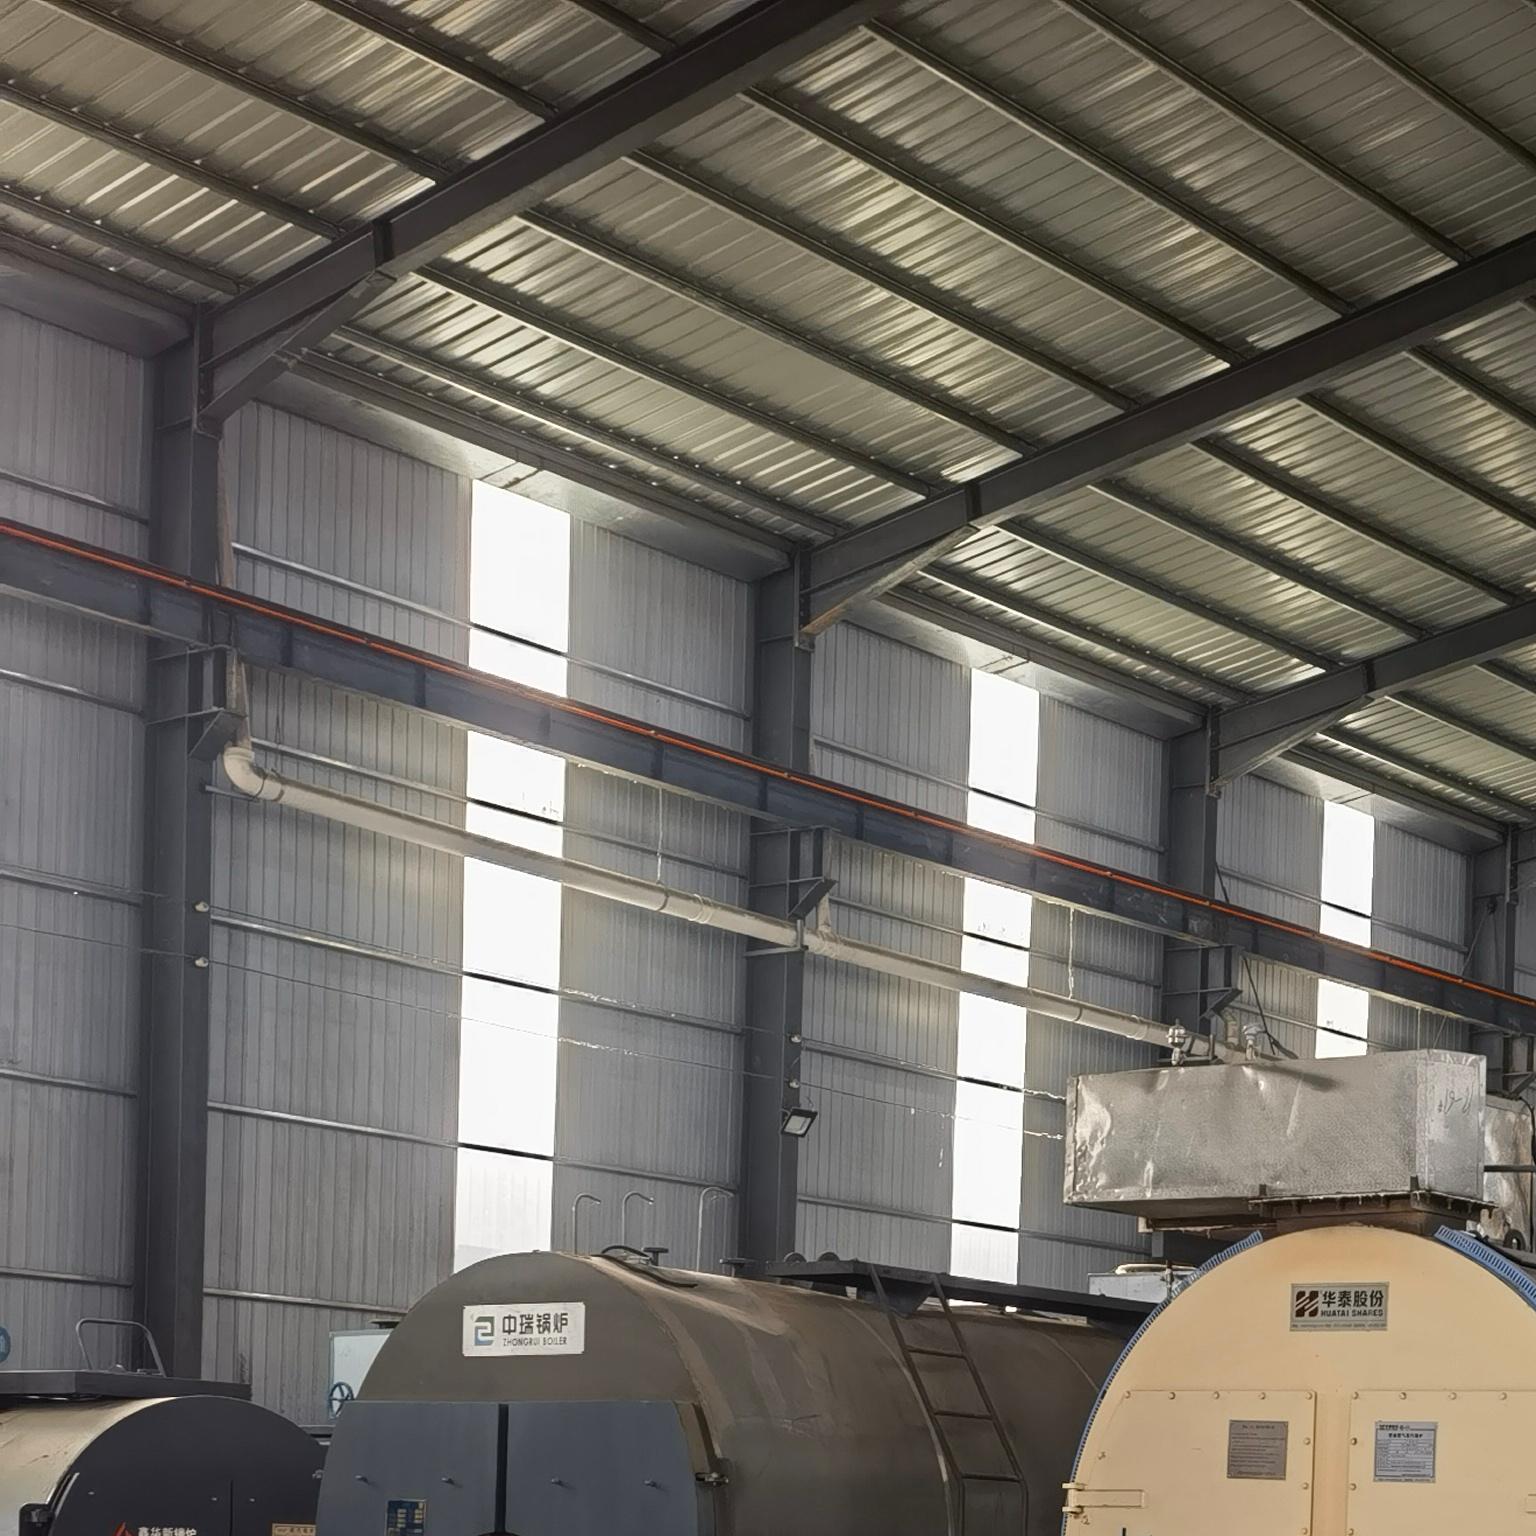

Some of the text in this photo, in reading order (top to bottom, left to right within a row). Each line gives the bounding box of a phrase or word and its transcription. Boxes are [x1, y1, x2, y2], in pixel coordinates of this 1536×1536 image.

[1321, 1290, 1384, 1308] 华泰股份
[1321, 1309, 1384, 1317] HUATAI SHARES
[502, 1312, 568, 1335] 中瑞锅炉
